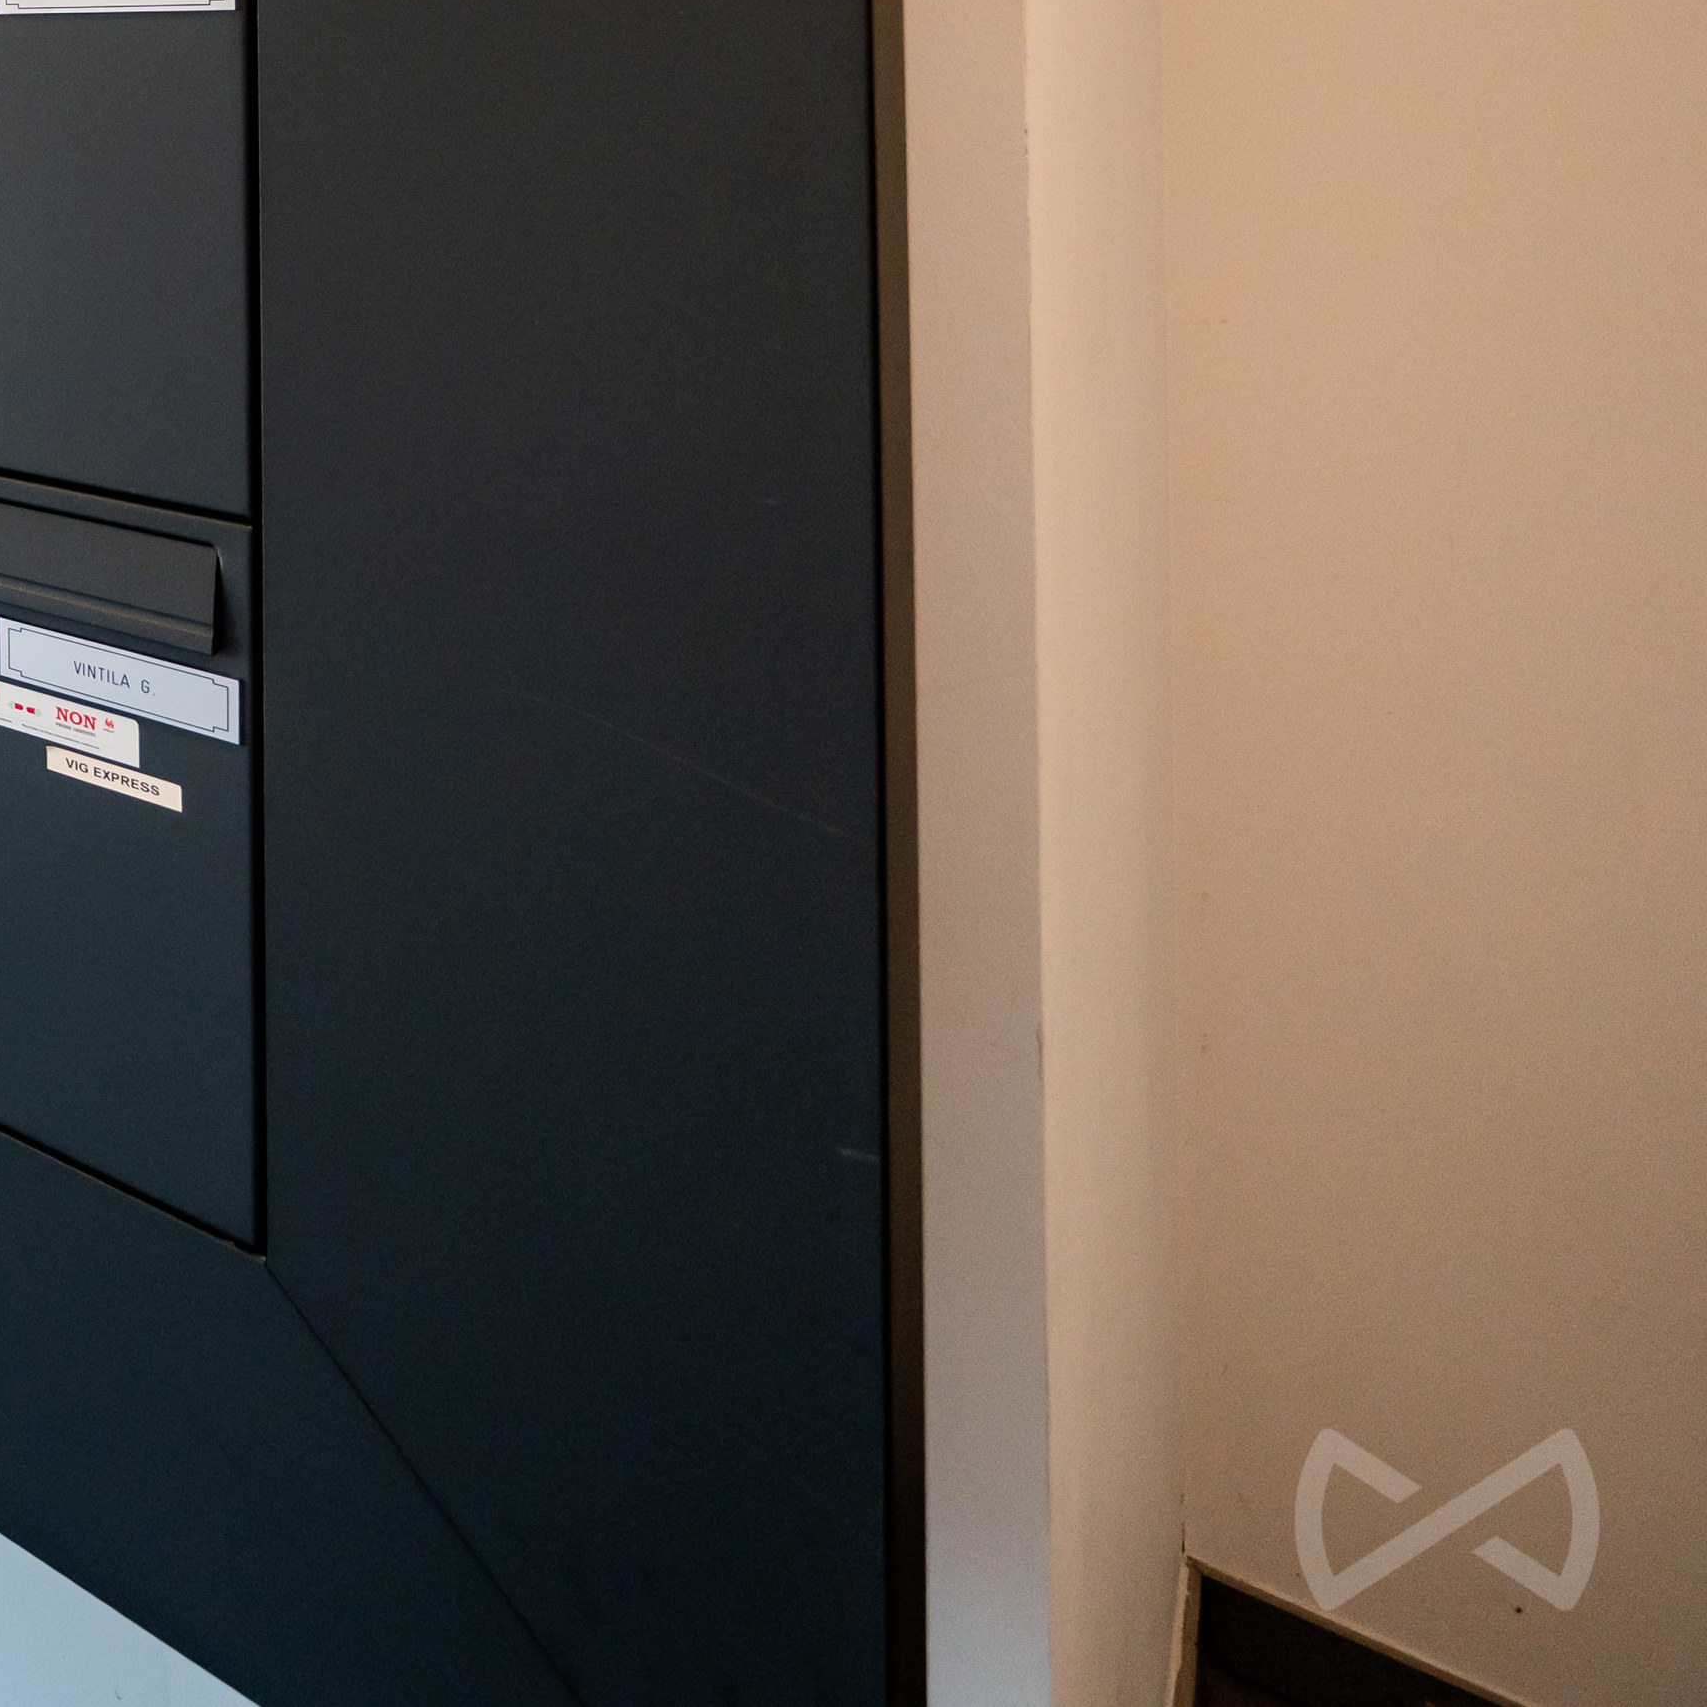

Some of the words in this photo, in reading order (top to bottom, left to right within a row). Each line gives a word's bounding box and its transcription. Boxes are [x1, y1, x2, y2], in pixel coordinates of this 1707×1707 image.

[73, 660, 130, 689] VINTILA
[55, 706, 97, 731] NON
[65, 757, 89, 774] VIG
[93, 767, 161, 797] EXPRESS
